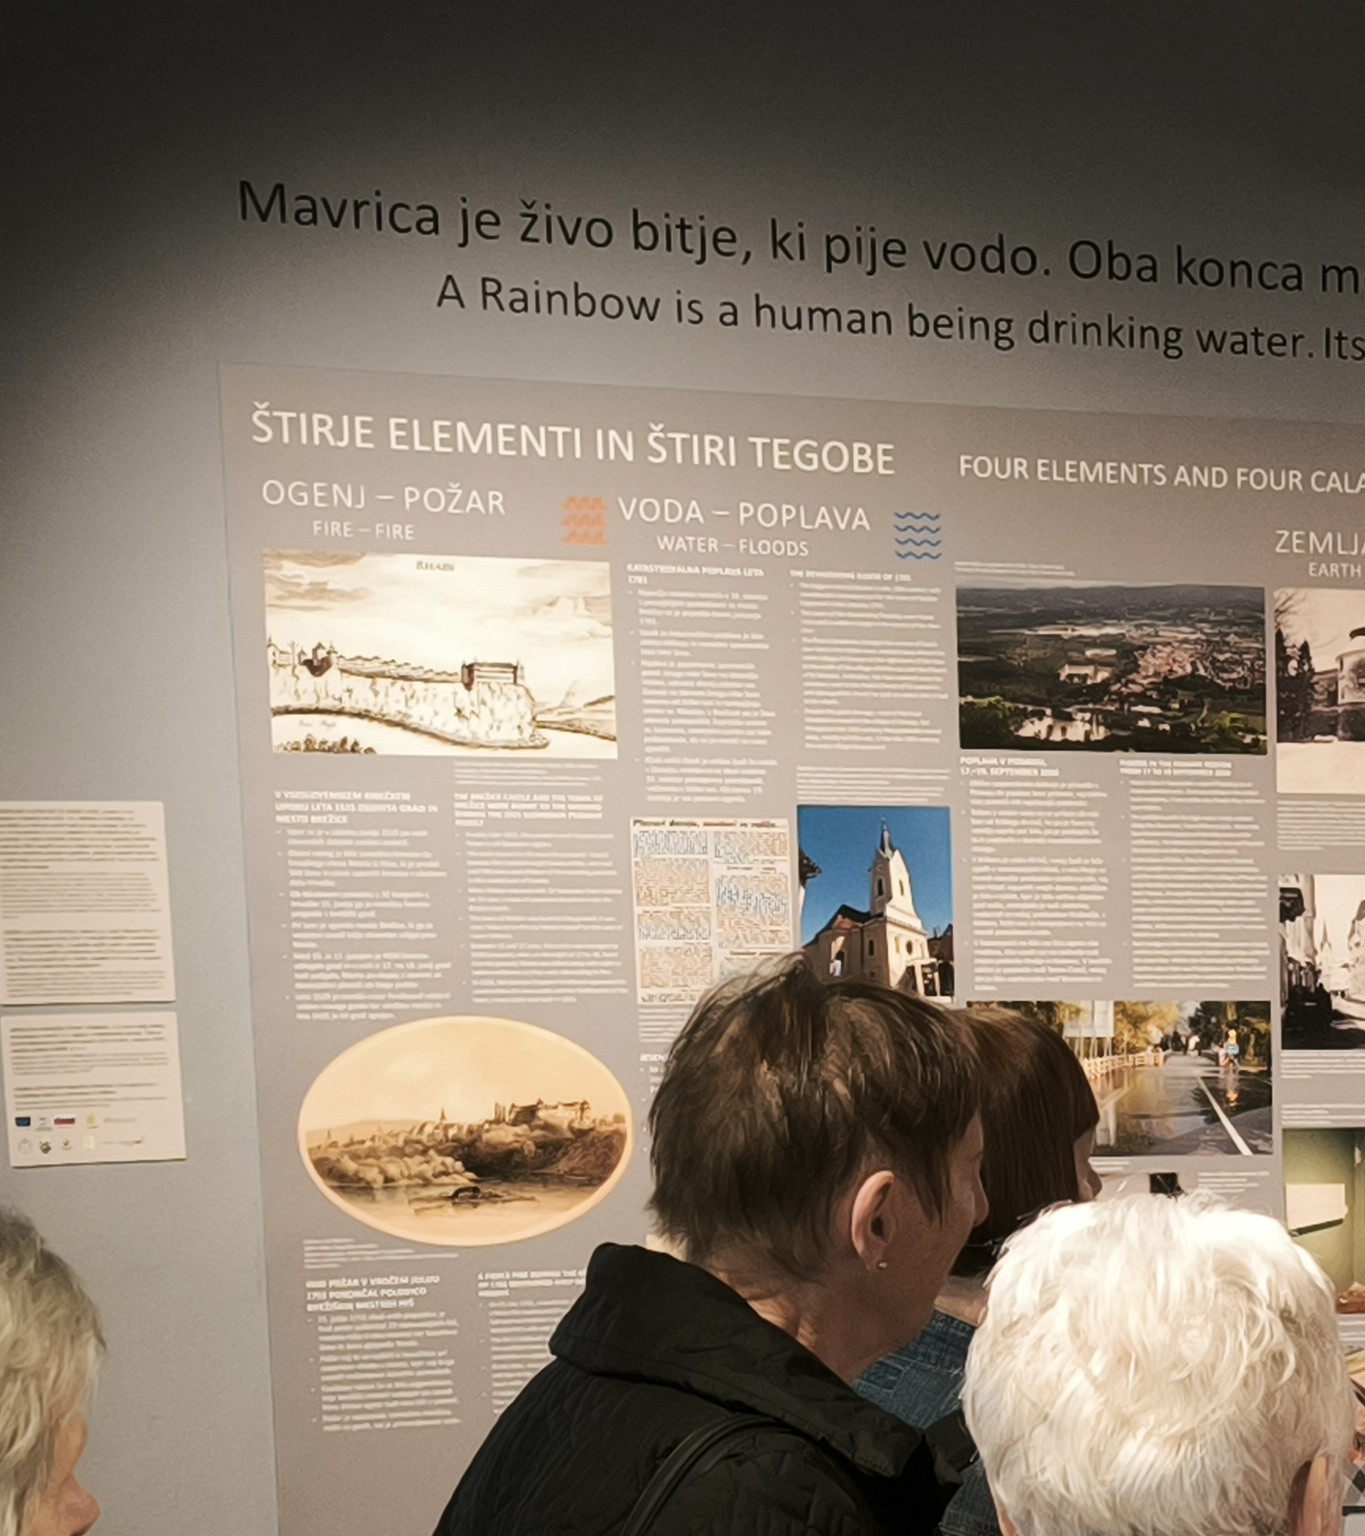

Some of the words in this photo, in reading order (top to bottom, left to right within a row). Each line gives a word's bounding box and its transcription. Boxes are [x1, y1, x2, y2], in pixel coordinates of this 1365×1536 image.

[238, 179, 439, 235] Mavrica
[457, 196, 501, 248] je
[519, 198, 613, 248] živo
[632, 207, 752, 265] bitje,
[770, 217, 805, 261] ki
[825, 225, 907, 276] pije
[922, 232, 1050, 276] vodo.
[1069, 239, 1158, 283] Oba
[1176, 244, 1303, 292] konca
[436, 274, 466, 309] A
[480, 276, 661, 322] Rainbow
[676, 289, 704, 325] is
[718, 301, 738, 327] a
[754, 292, 892, 336] human
[908, 302, 1015, 352] being
[1028, 309, 1184, 360] drinking
[1196, 326, 1314, 358] water.
[1325, 327, 1365, 361] Its
[252, 401, 375, 449] ŠTIRJE
[389, 417, 581, 459] ELEMENTI
[596, 429, 634, 462] IN
[647, 423, 736, 467] ŠTIRI
[747, 436, 895, 475] TEGOBE
[959, 454, 1029, 480] FOUR
[1037, 458, 1167, 486] ELEMENTS
[1173, 465, 1228, 489] AND
[1236, 467, 1303, 492] FOUR
[262, 479, 365, 509] OGENJ
[404, 482, 505, 515] POŽAR
[617, 497, 705, 524] VODA
[739, 501, 870, 531] POPLAVA
[313, 520, 353, 538] FIRE
[375, 523, 415, 541] FIRE
[656, 535, 719, 553] WATER
[739, 538, 809, 557] FLOODS
[1308, 562, 1362, 578] EARTH
